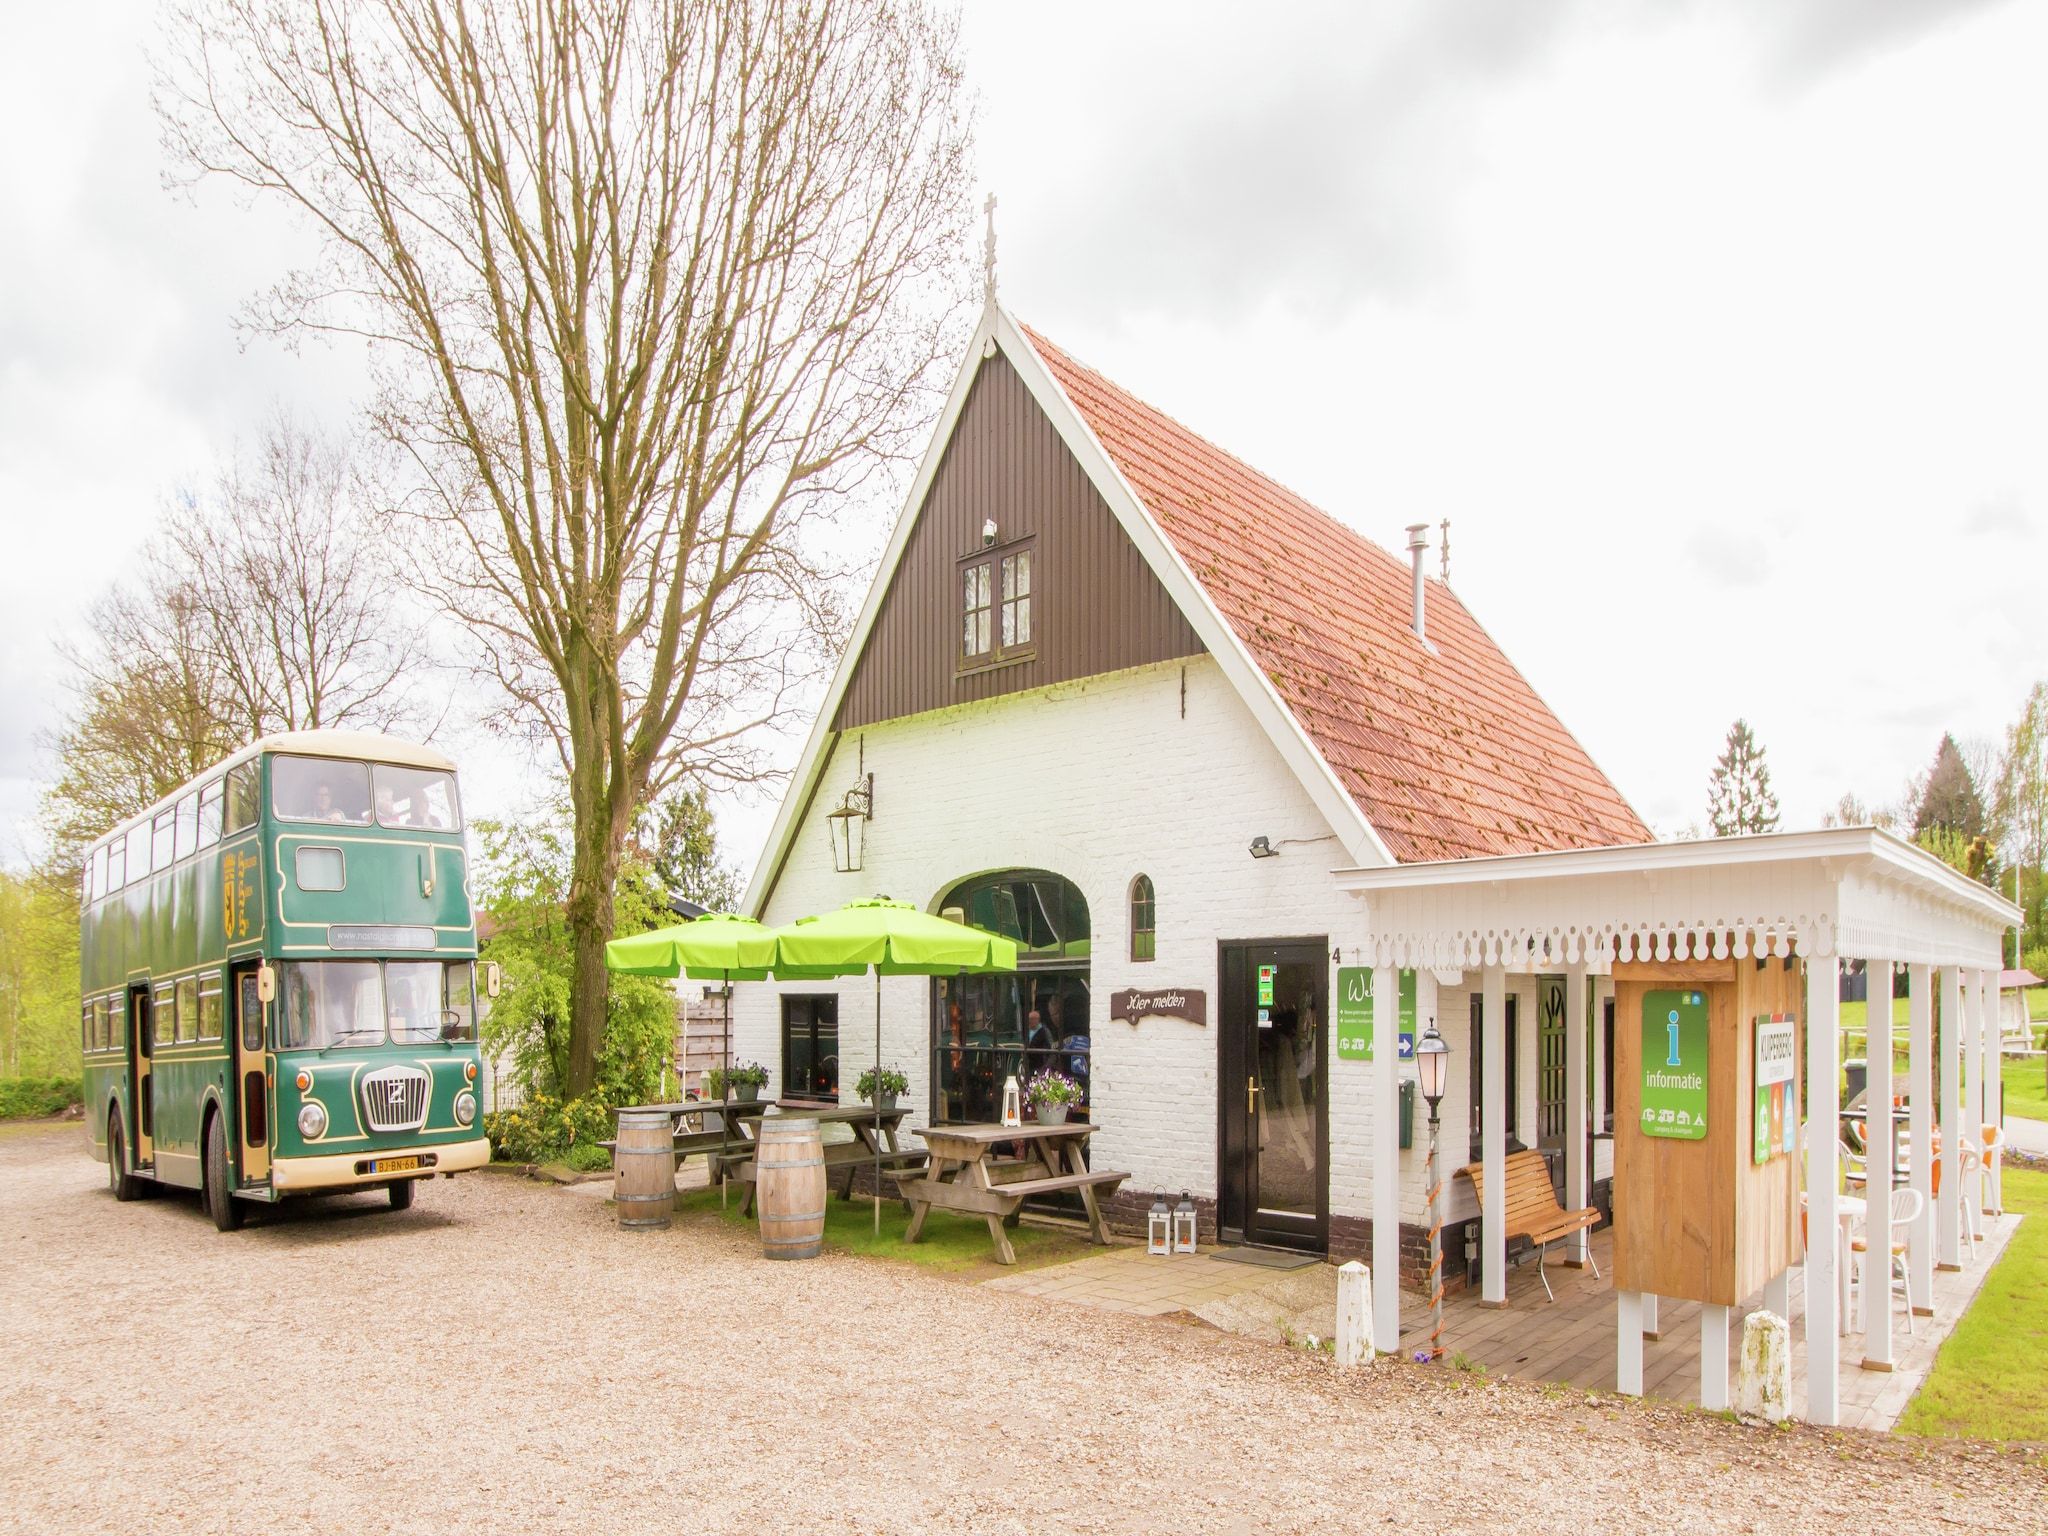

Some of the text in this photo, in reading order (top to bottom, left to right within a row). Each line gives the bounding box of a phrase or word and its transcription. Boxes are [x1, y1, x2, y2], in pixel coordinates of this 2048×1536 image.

[1332, 947, 1341, 964] 4
[1127, 991, 1185, 1010] Hier melden
[1646, 1070, 1702, 1090] informatie
[378, 1159, 416, 1172] BJ-BN-66
